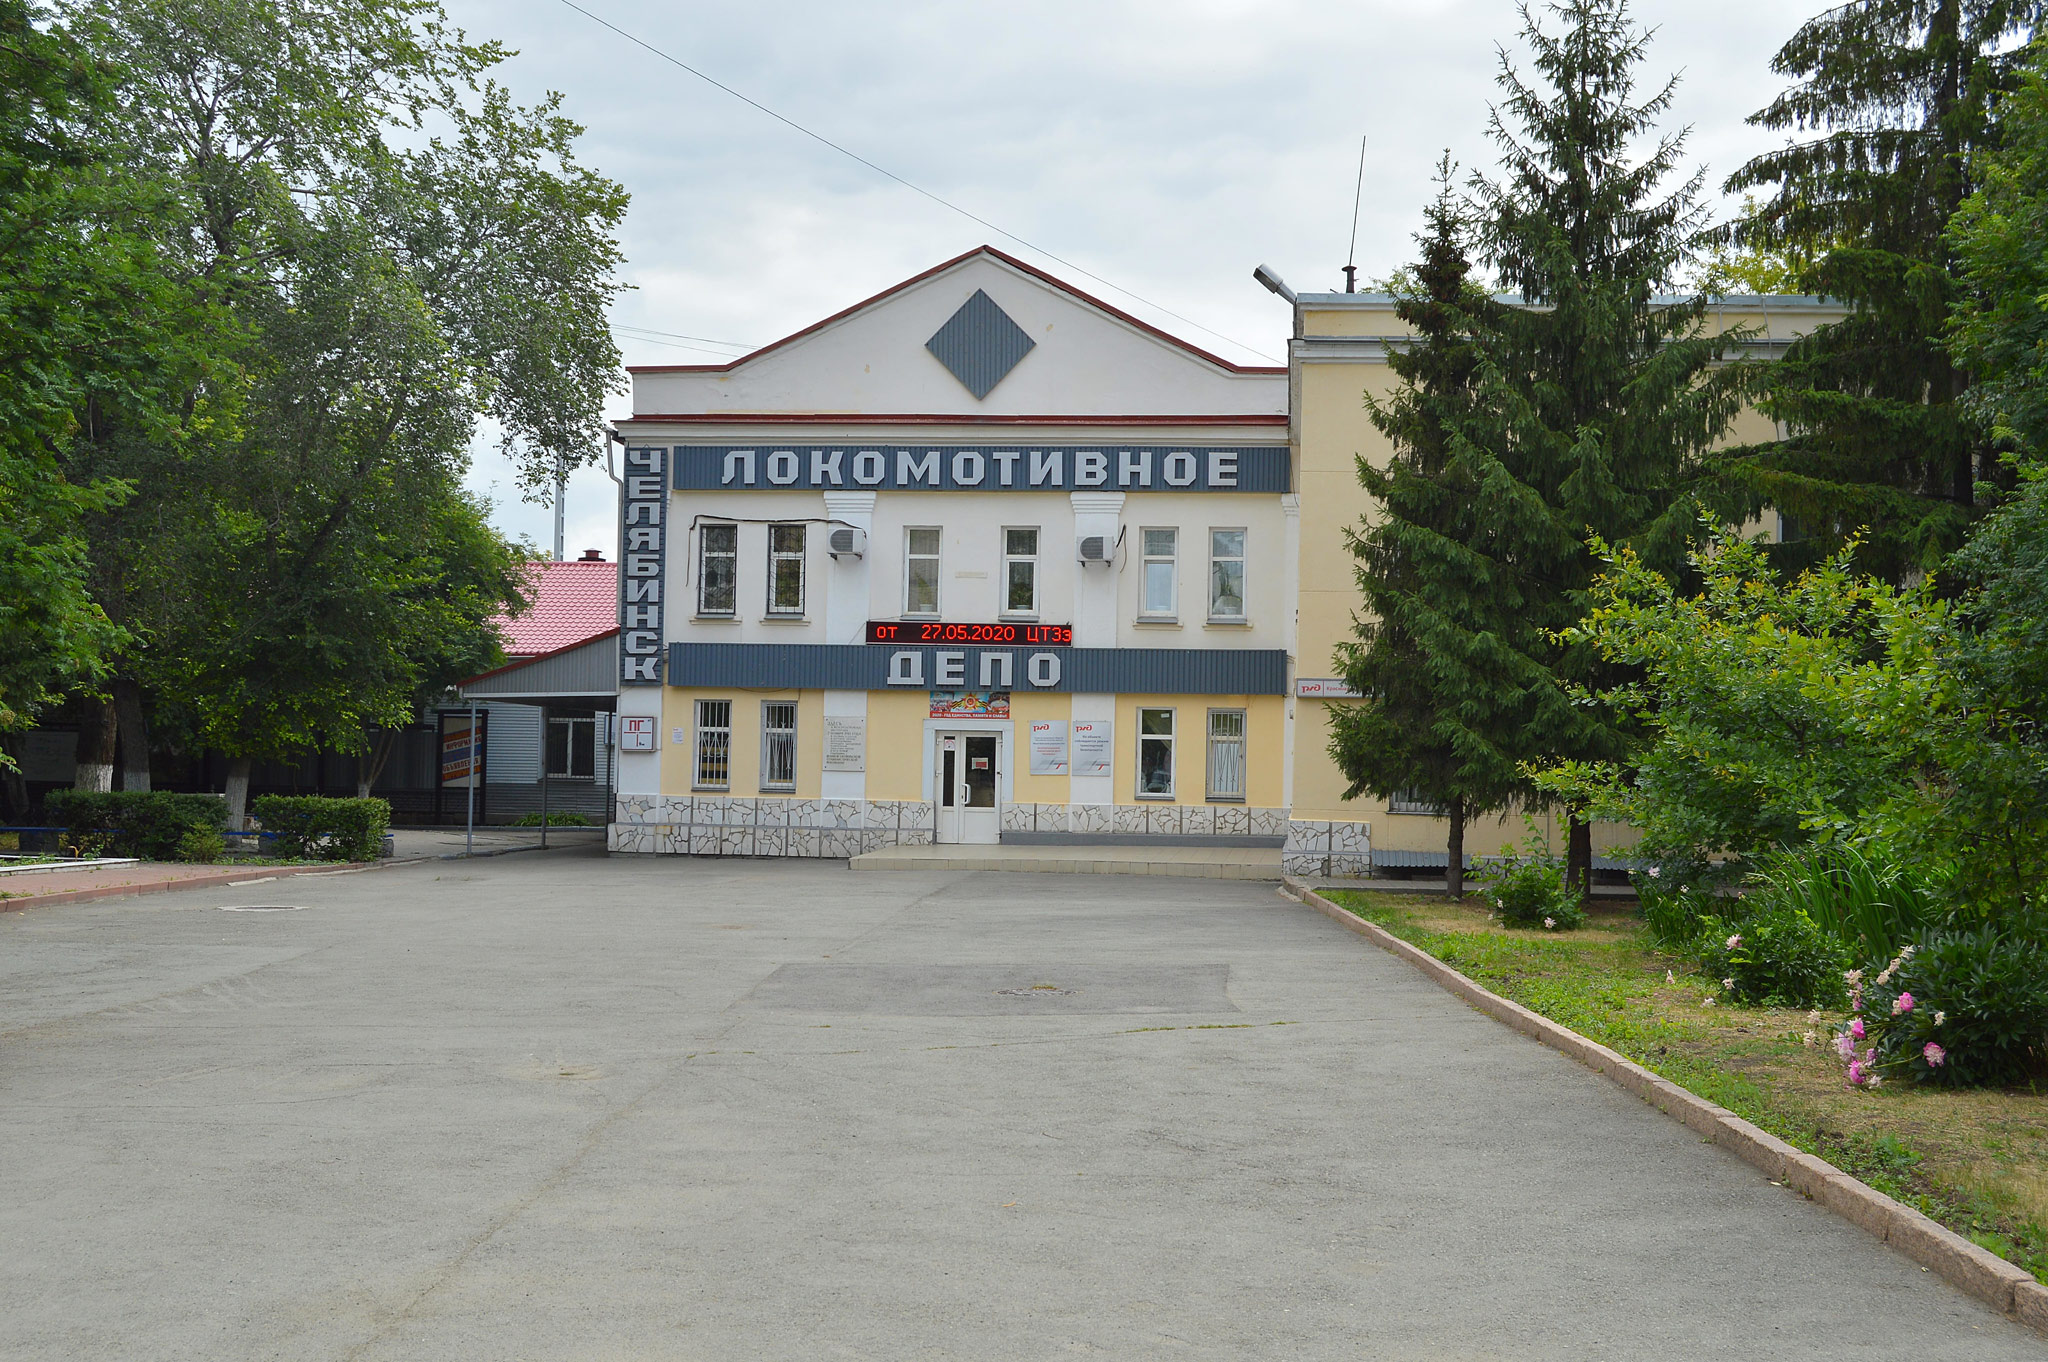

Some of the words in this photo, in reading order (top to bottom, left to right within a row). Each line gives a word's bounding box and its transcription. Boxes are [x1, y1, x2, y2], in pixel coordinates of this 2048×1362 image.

[721, 449, 1238, 487] ЛОКОМОТИВНОЕ
[624, 449, 662, 681] ЧЕЛЯБИНСК
[921, 624, 1016, 642] 27.05.2020
[887, 651, 1061, 687] ДЕПО
